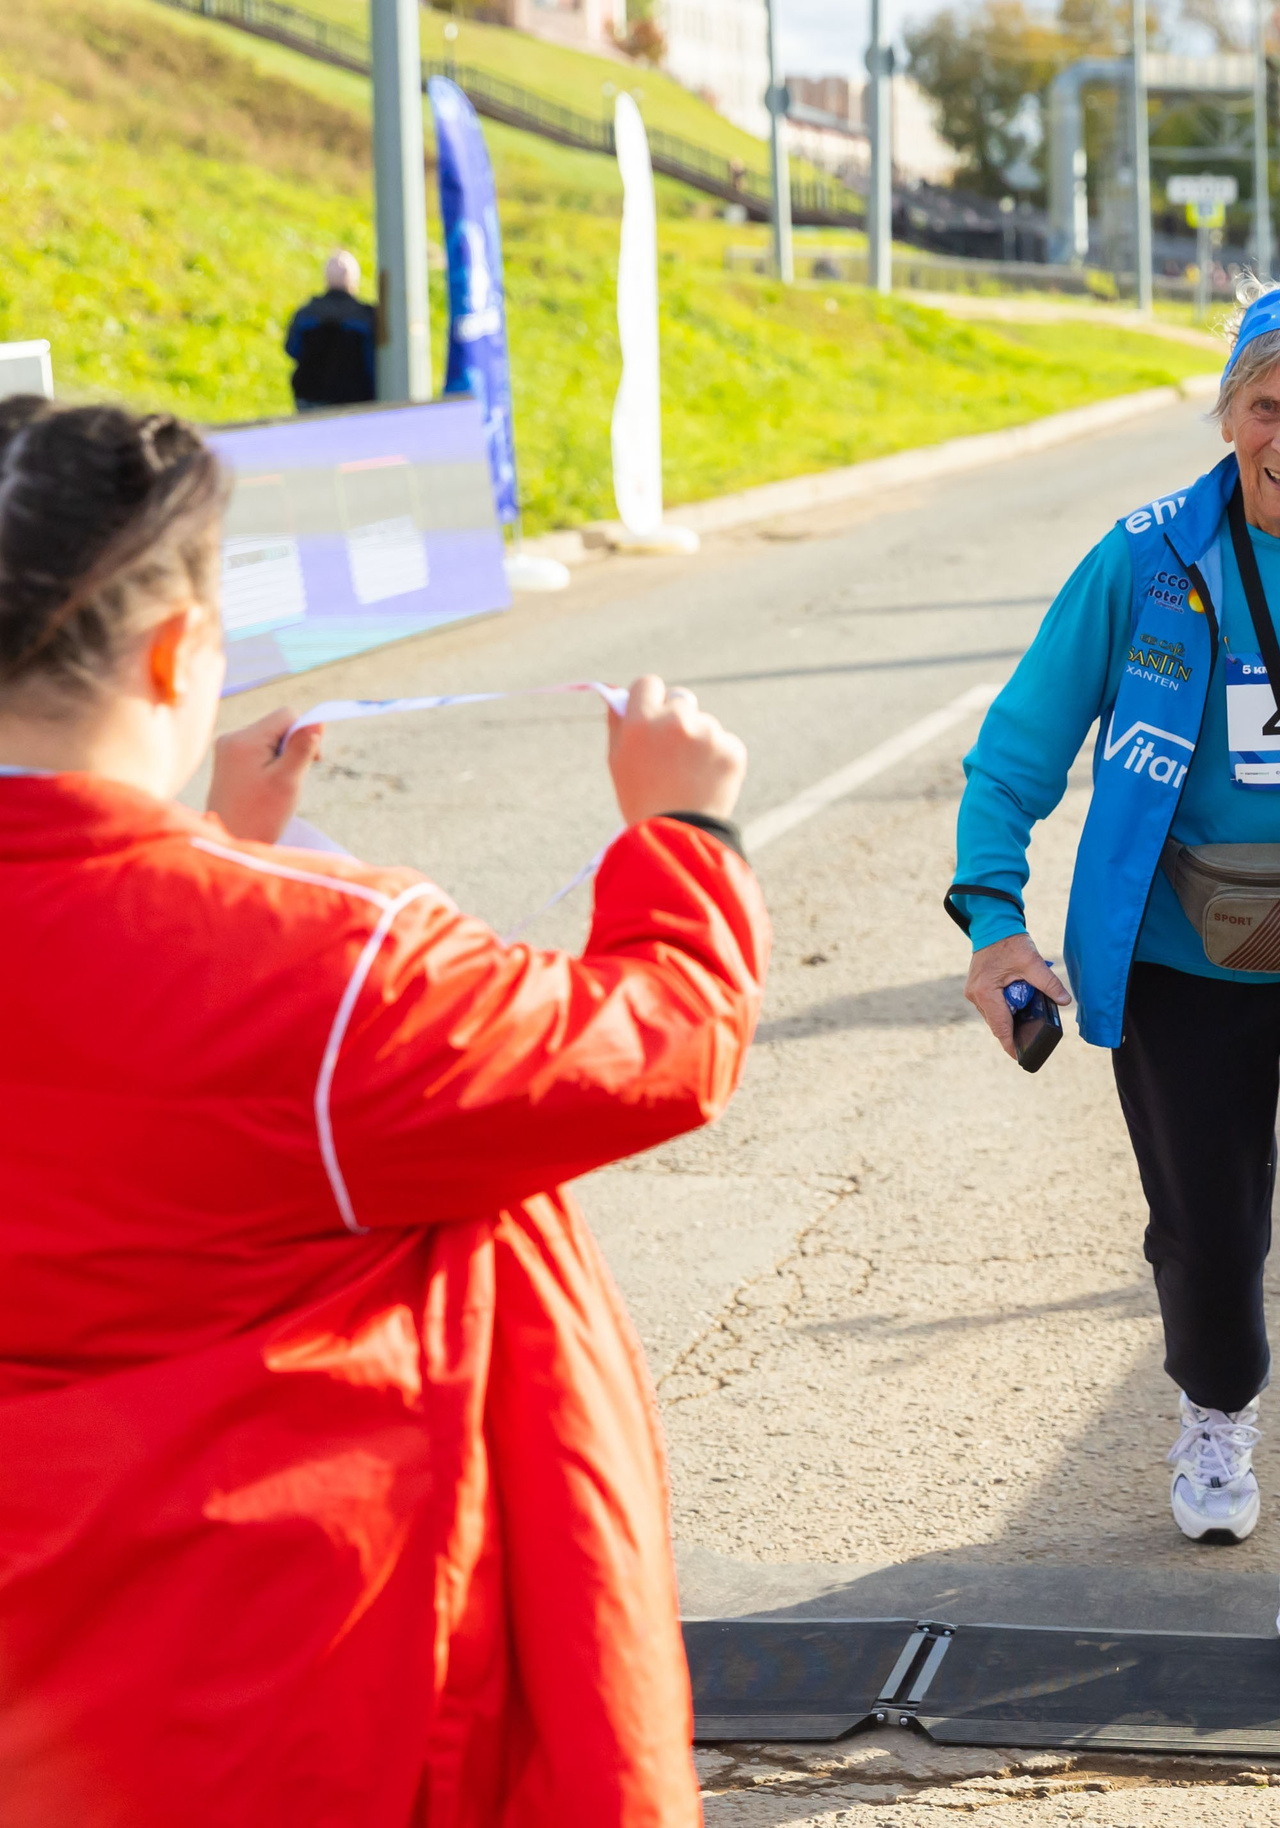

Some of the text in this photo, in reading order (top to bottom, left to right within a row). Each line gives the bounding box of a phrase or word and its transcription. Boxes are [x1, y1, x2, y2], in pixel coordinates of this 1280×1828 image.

[1242, 665, 1251, 675] 5
[1125, 665, 1180, 692] XANTEN
[1214, 912, 1253, 926] SPORT
